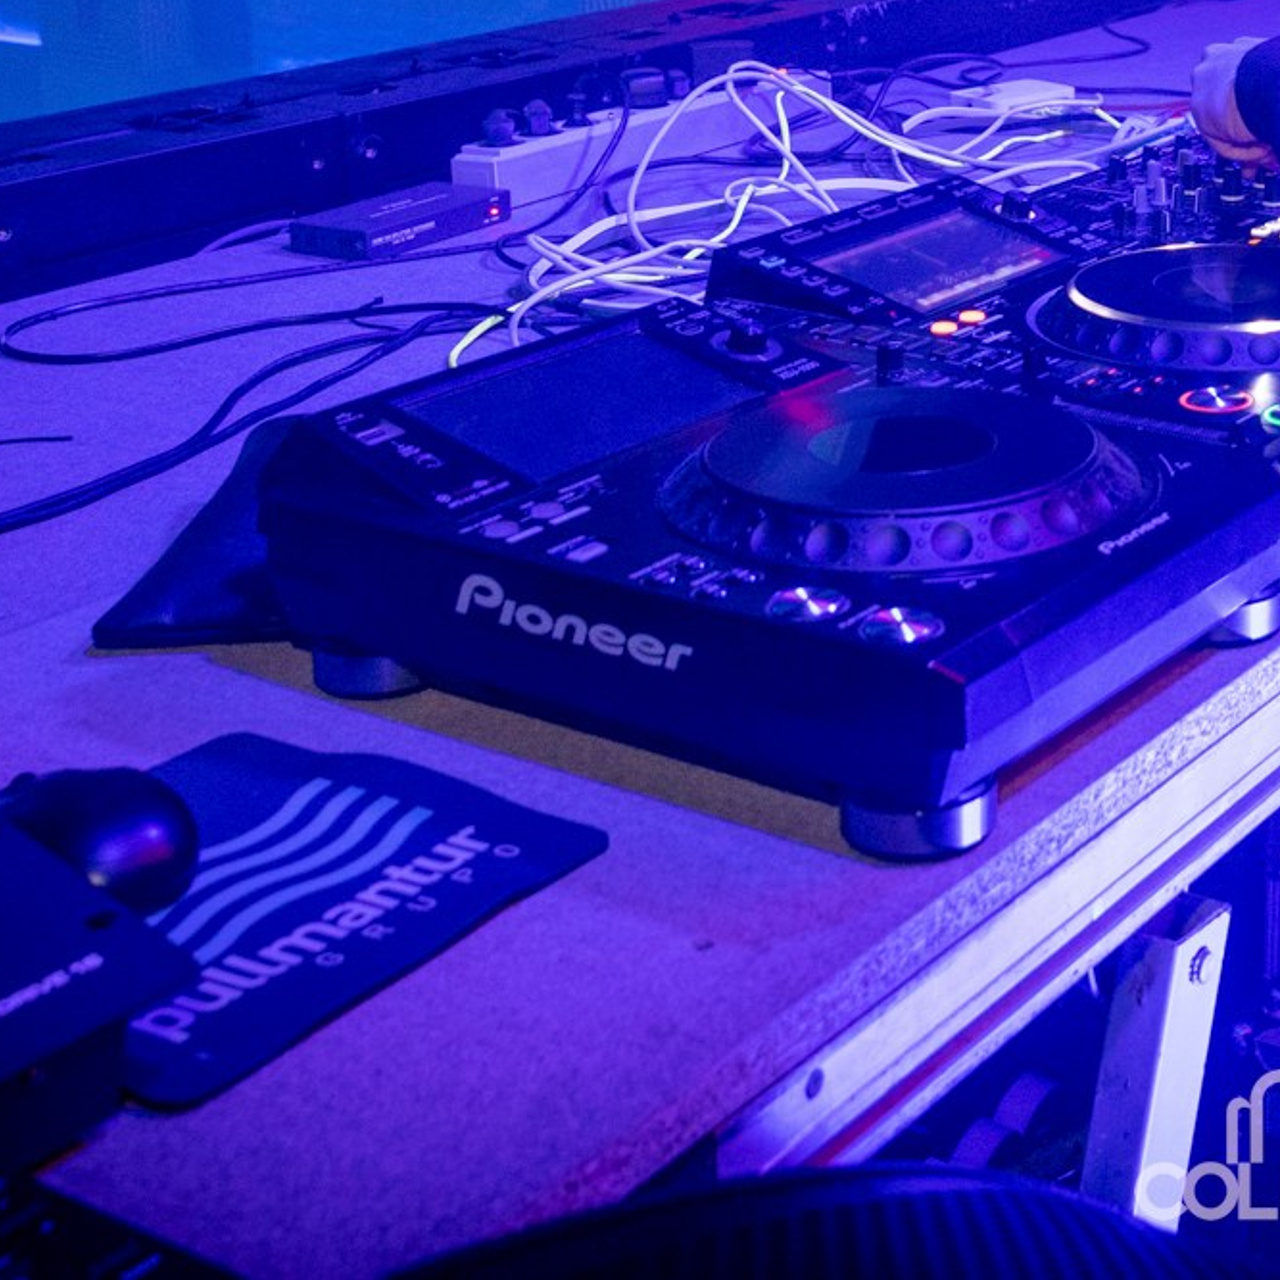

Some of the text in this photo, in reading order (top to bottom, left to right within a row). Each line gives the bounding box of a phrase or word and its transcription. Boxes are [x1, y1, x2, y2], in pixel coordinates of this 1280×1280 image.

[1097, 511, 1171, 556] Pioneer
[455, 573, 693, 672] Pioneer
[130, 824, 490, 1043] pullmantur
[315, 843, 521, 967] GRUPO
